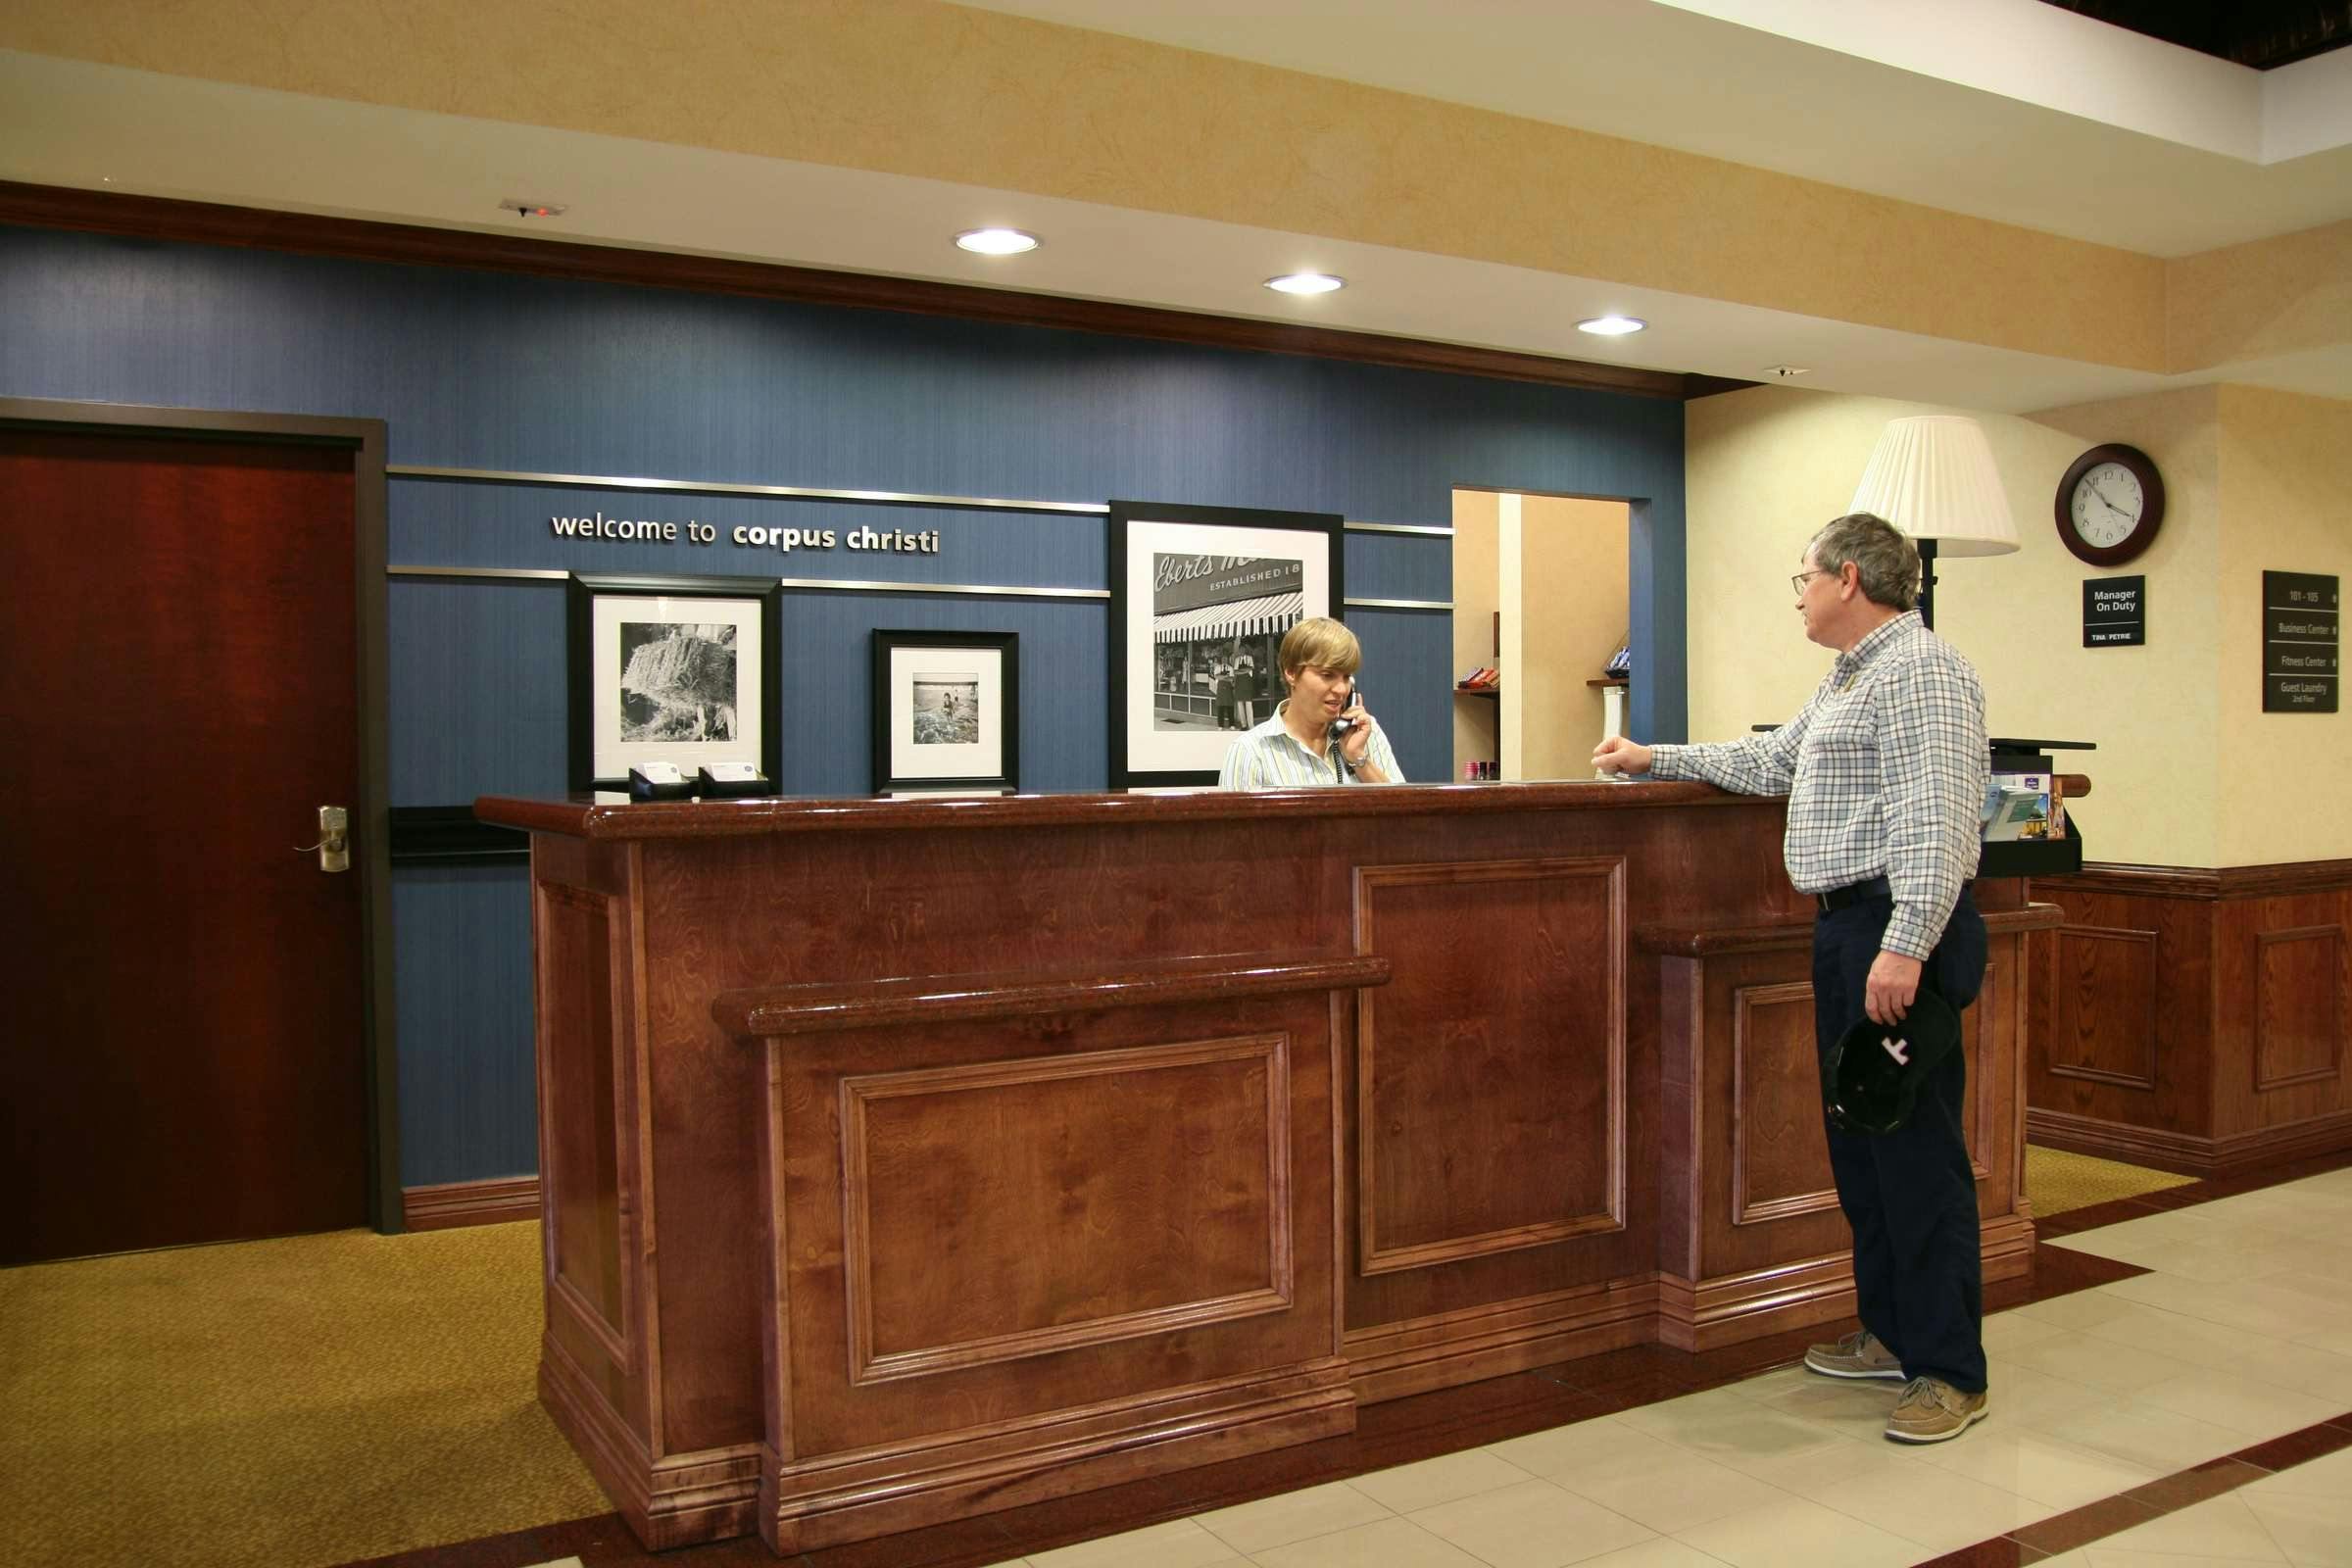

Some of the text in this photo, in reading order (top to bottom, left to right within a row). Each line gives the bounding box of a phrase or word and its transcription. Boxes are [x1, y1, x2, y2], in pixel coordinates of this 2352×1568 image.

[551, 513, 940, 554] welcome to corpus christi
[1154, 556, 1214, 592] Eberts
[1209, 568, 1281, 591] ESTABLISHED
[2093, 590, 2136, 601] Manager
[2096, 601, 2136, 612] On Duty
[2278, 622, 2328, 634] Business Center
[2281, 655, 2327, 666] Fitness Center
[2281, 682, 2328, 696] Guest Laundry
